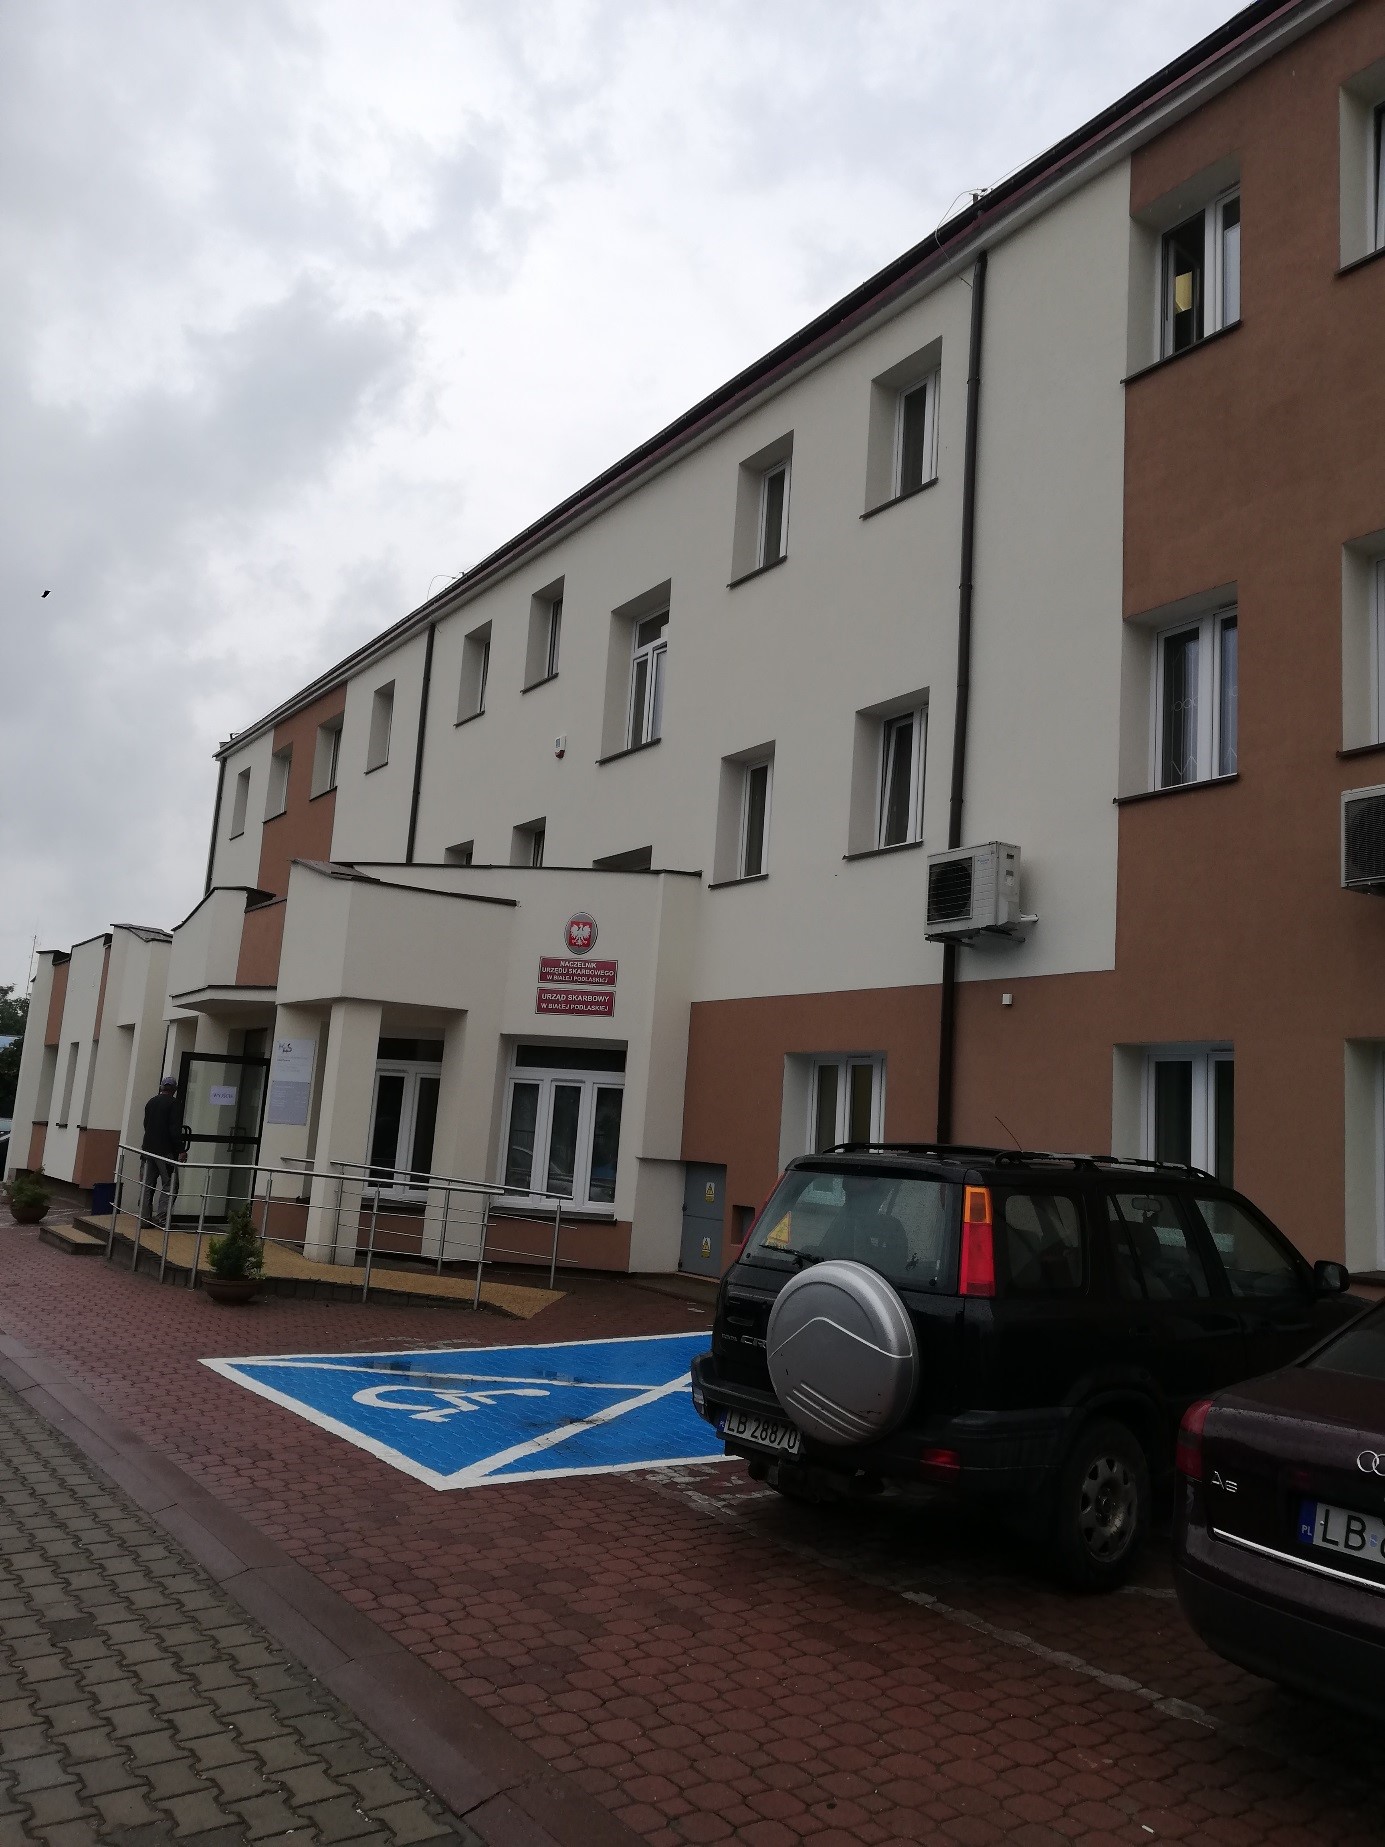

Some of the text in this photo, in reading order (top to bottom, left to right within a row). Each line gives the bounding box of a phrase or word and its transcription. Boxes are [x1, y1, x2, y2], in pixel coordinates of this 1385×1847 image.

[541, 967, 615, 977] URZĘDU SKARBOWEGO
[541, 993, 610, 1003] URZĄD SKARBOWY
[570, 1004, 609, 1012] PODLASKIEJ
[727, 1409, 798, 1450] LB 28870
[1301, 1524, 1313, 1537] PL
[1321, 1508, 1367, 1552] LB
